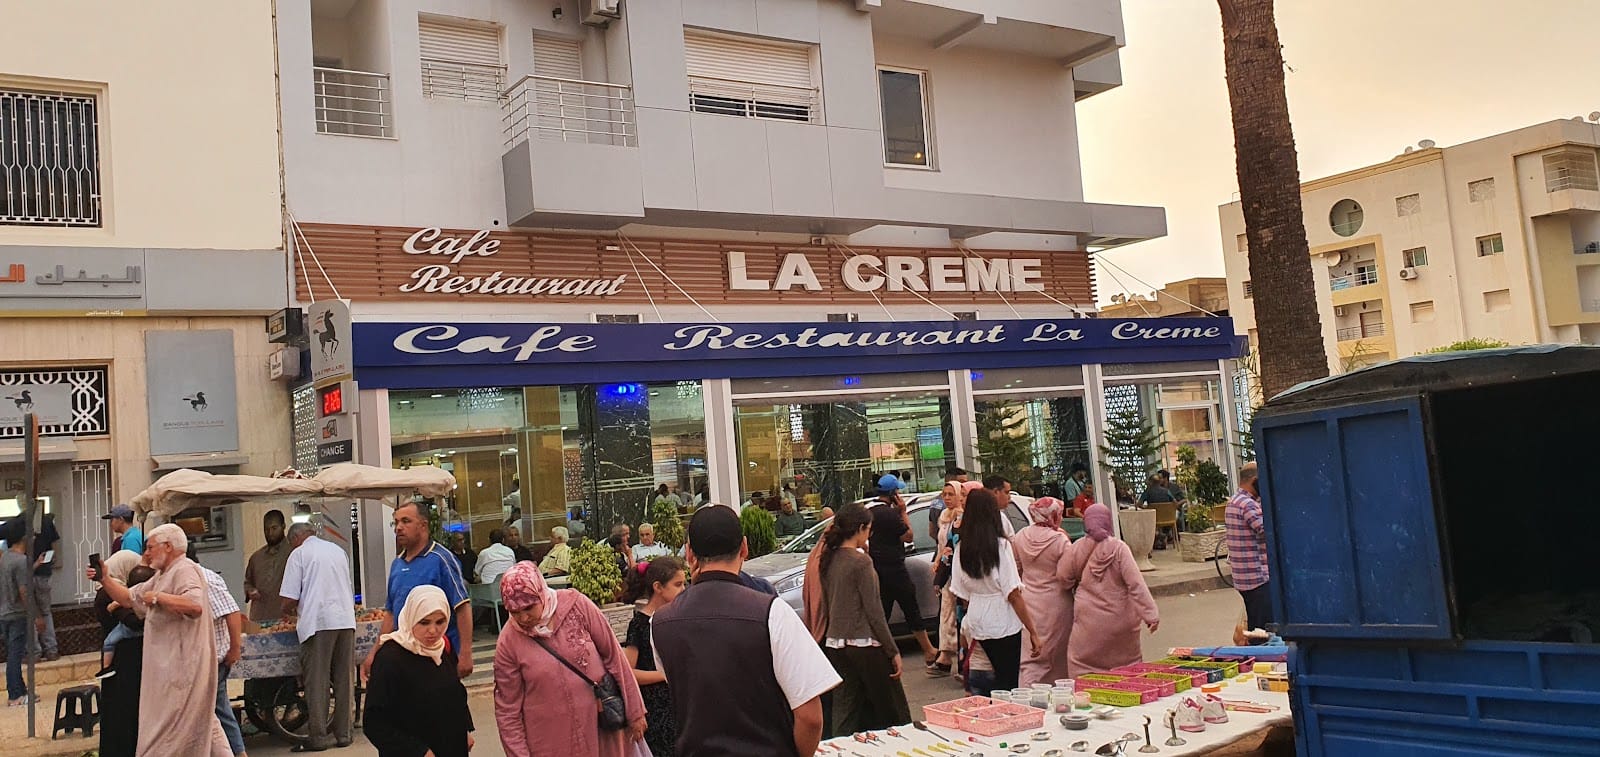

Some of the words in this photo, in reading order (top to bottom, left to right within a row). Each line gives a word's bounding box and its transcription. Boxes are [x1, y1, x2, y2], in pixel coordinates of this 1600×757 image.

[402, 227, 501, 264] Cafe
[35, 264, 141, 288] البنك
[398, 264, 628, 297] Restaurant
[727, 250, 823, 292] LA
[840, 254, 1045, 293] CREME
[393, 324, 597, 362] Cafe
[663, 322, 1006, 351] Restaurant
[1022, 322, 1085, 342] La
[1111, 320, 1221, 342] Creme
[320, 444, 345, 458] CHANGE
